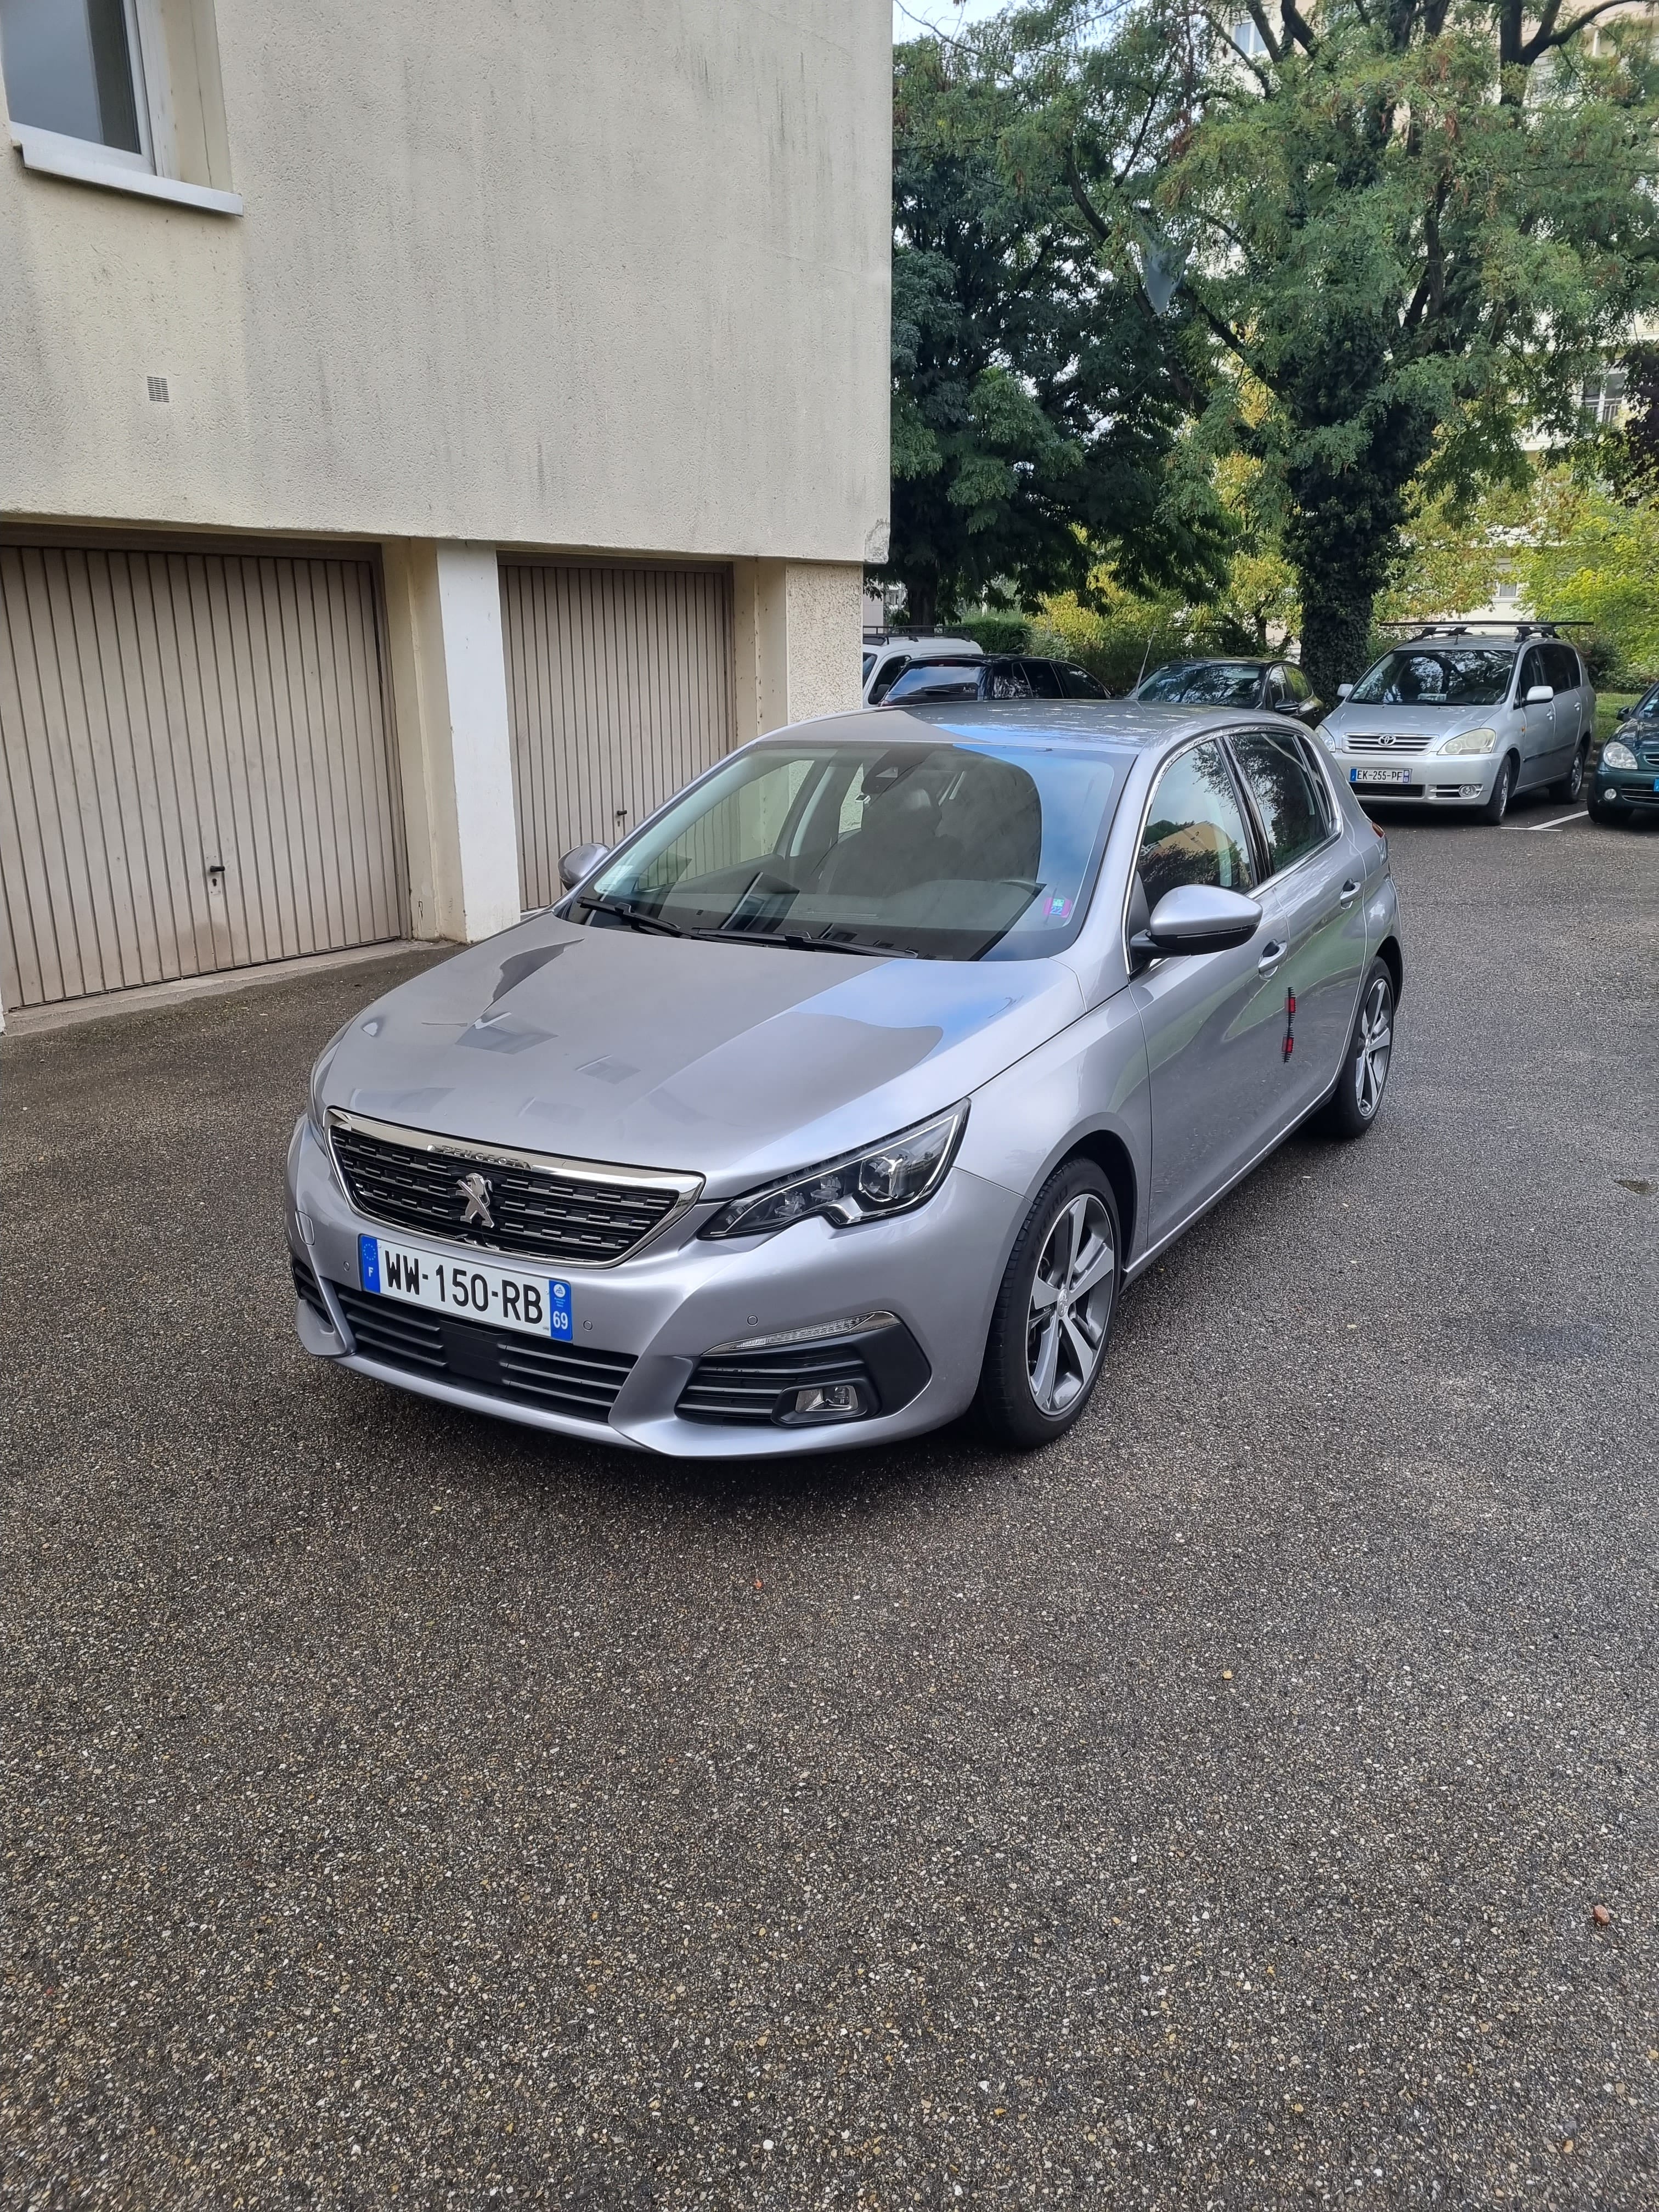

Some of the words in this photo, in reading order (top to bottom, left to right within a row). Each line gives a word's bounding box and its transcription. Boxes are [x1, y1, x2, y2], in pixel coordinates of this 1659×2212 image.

[1357, 770, 1403, 781] EK-255-PF
[1049, 906, 1063, 915] 22
[442, 1145, 518, 1167] PEUGEOT
[368, 1266, 374, 1277] F
[385, 1250, 543, 1324] WW-150-RB
[553, 1311, 568, 1330] 69
